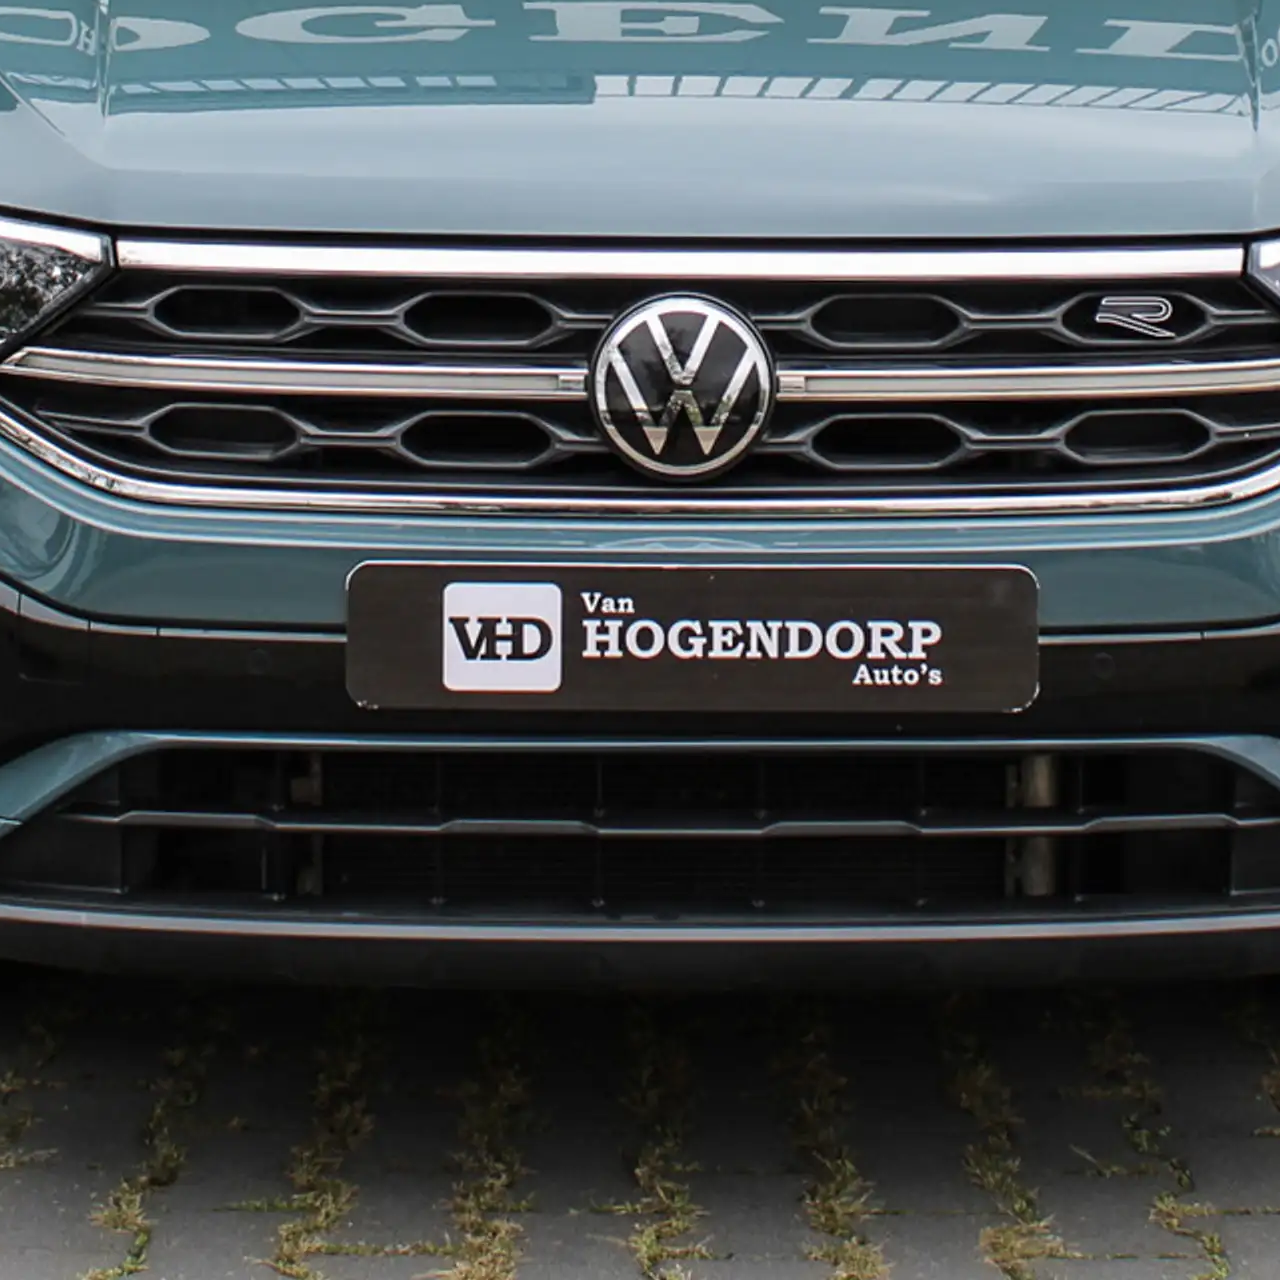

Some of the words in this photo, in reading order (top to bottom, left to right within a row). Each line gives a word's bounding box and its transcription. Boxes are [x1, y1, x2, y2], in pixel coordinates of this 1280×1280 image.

[581, 593, 634, 614] Van
[581, 619, 944, 660] HOGENDORP
[851, 664, 943, 687] Auto's
